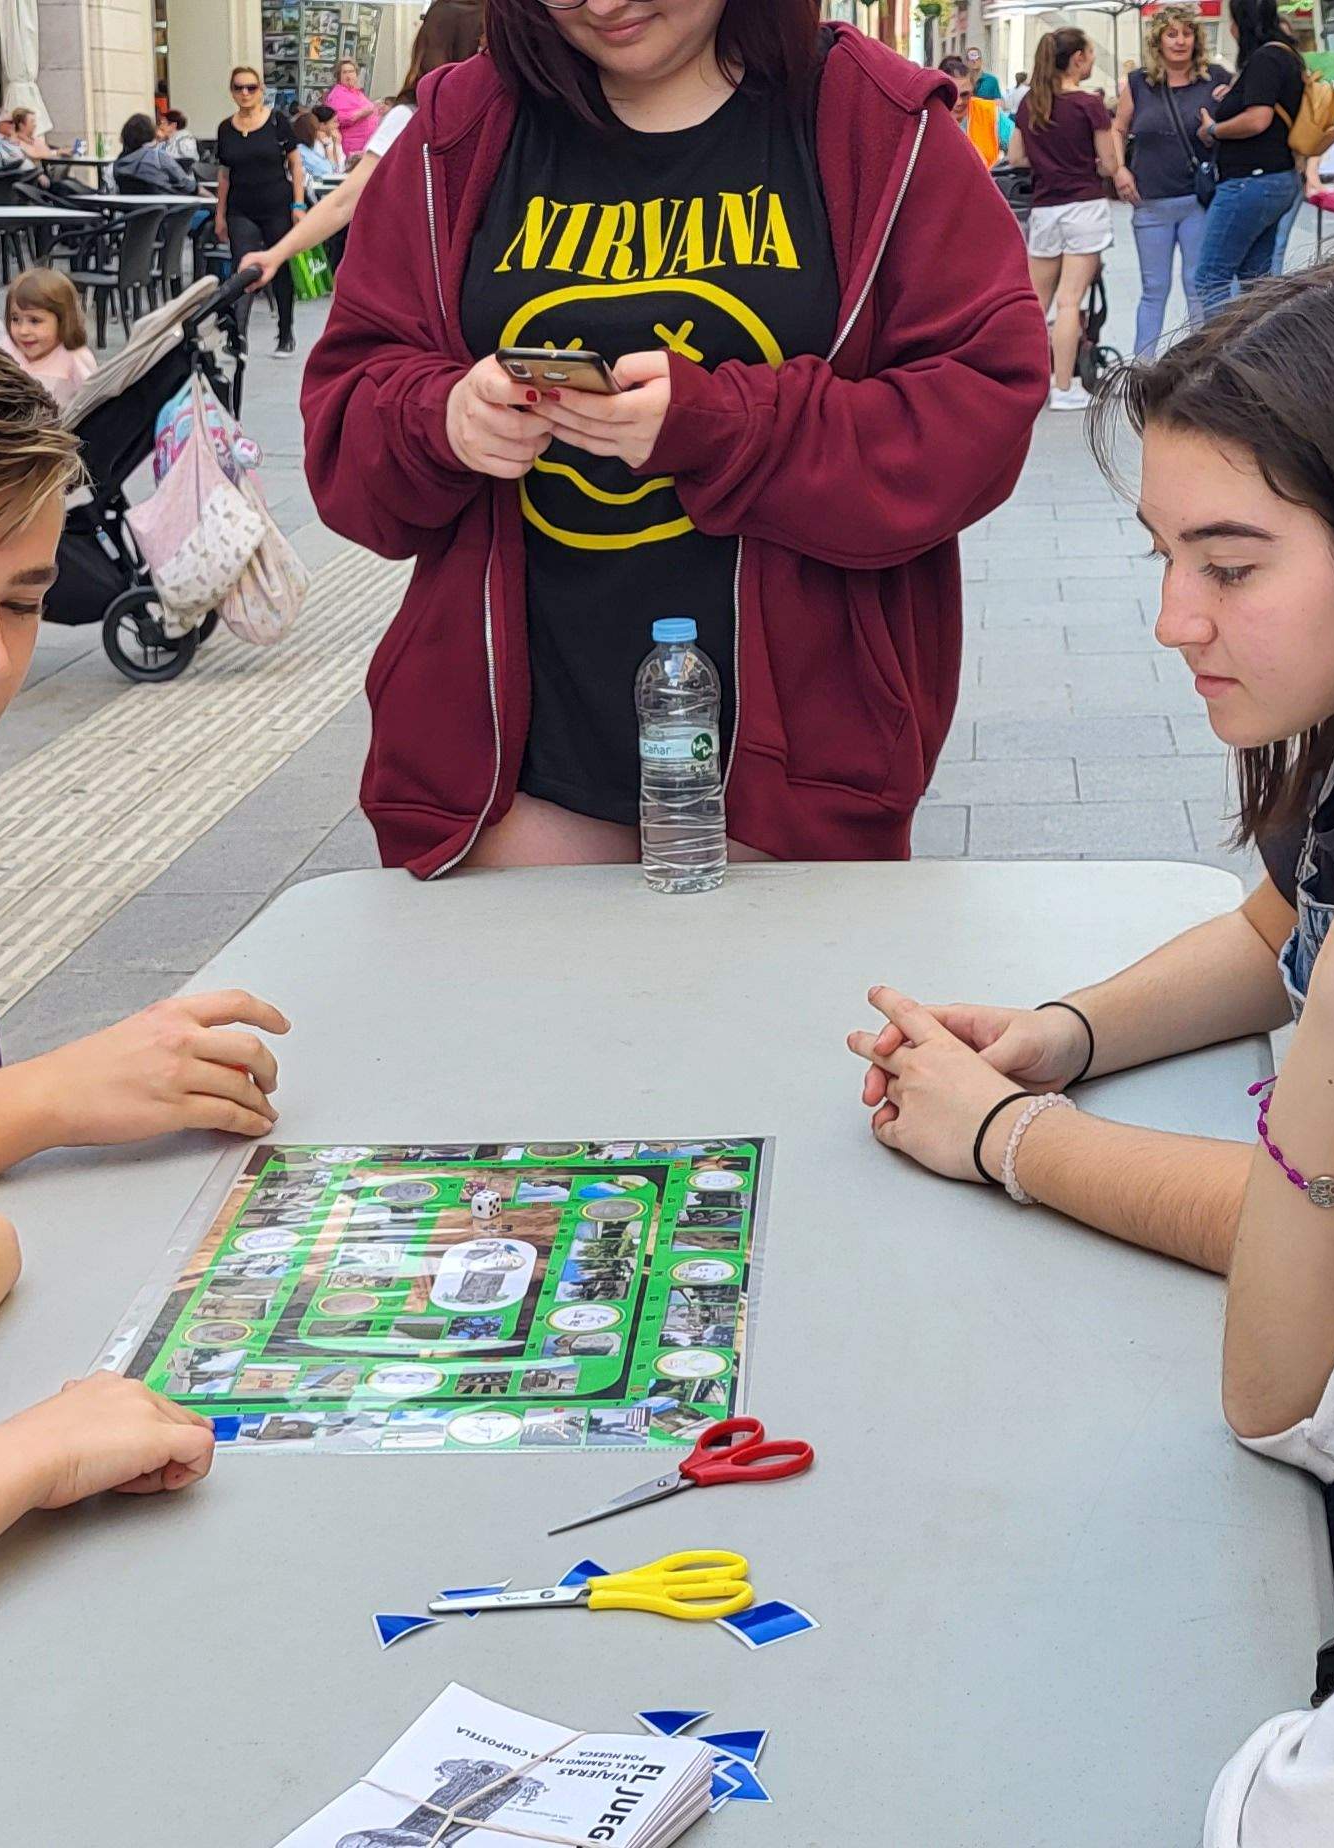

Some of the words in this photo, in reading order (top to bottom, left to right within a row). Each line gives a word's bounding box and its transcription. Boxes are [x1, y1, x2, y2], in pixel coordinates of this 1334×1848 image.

[493, 184, 801, 281] NIRVANA
[456, 1726, 528, 1757] COMPOSTELA
[556, 1768, 629, 1782] VIAJERAS
[565, 1758, 612, 1768] CAMINO
[628, 1763, 667, 1784] EL
[587, 1785, 645, 1843] JUEG
